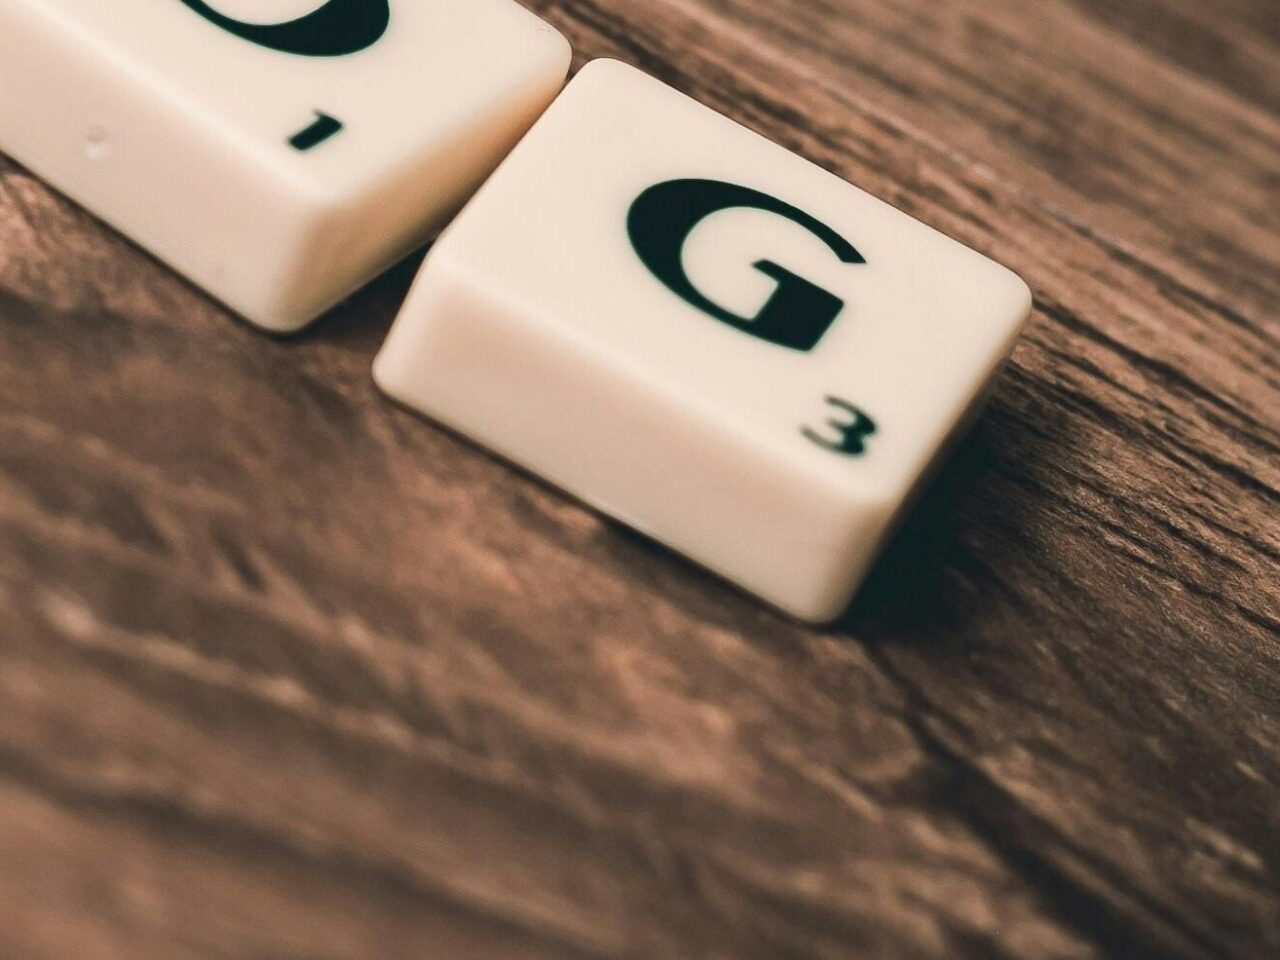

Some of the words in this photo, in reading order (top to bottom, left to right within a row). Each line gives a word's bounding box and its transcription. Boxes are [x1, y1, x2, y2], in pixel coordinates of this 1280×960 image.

[287, 111, 344, 152] 1
[625, 178, 867, 353] G
[803, 396, 878, 458] 3
